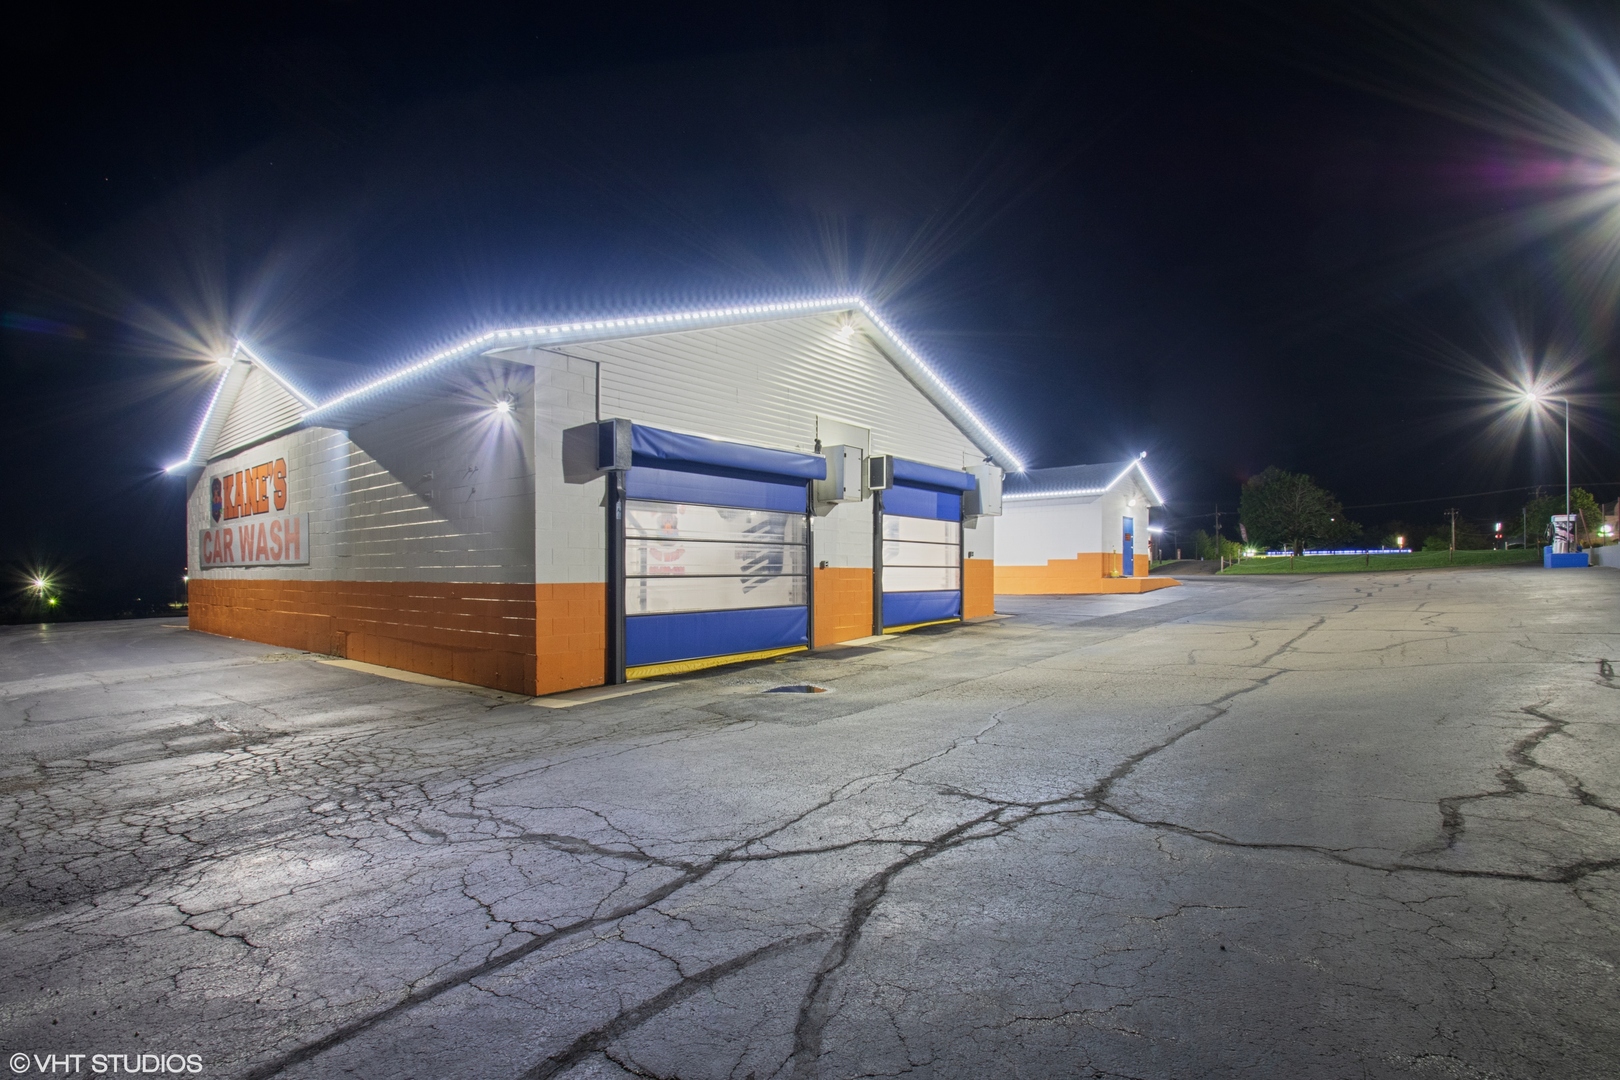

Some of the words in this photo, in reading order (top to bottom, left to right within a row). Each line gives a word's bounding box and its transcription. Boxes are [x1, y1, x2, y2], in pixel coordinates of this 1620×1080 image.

[223, 457, 288, 521] KANE'S
[203, 527, 235, 564] CAR
[238, 517, 300, 562] WASH
